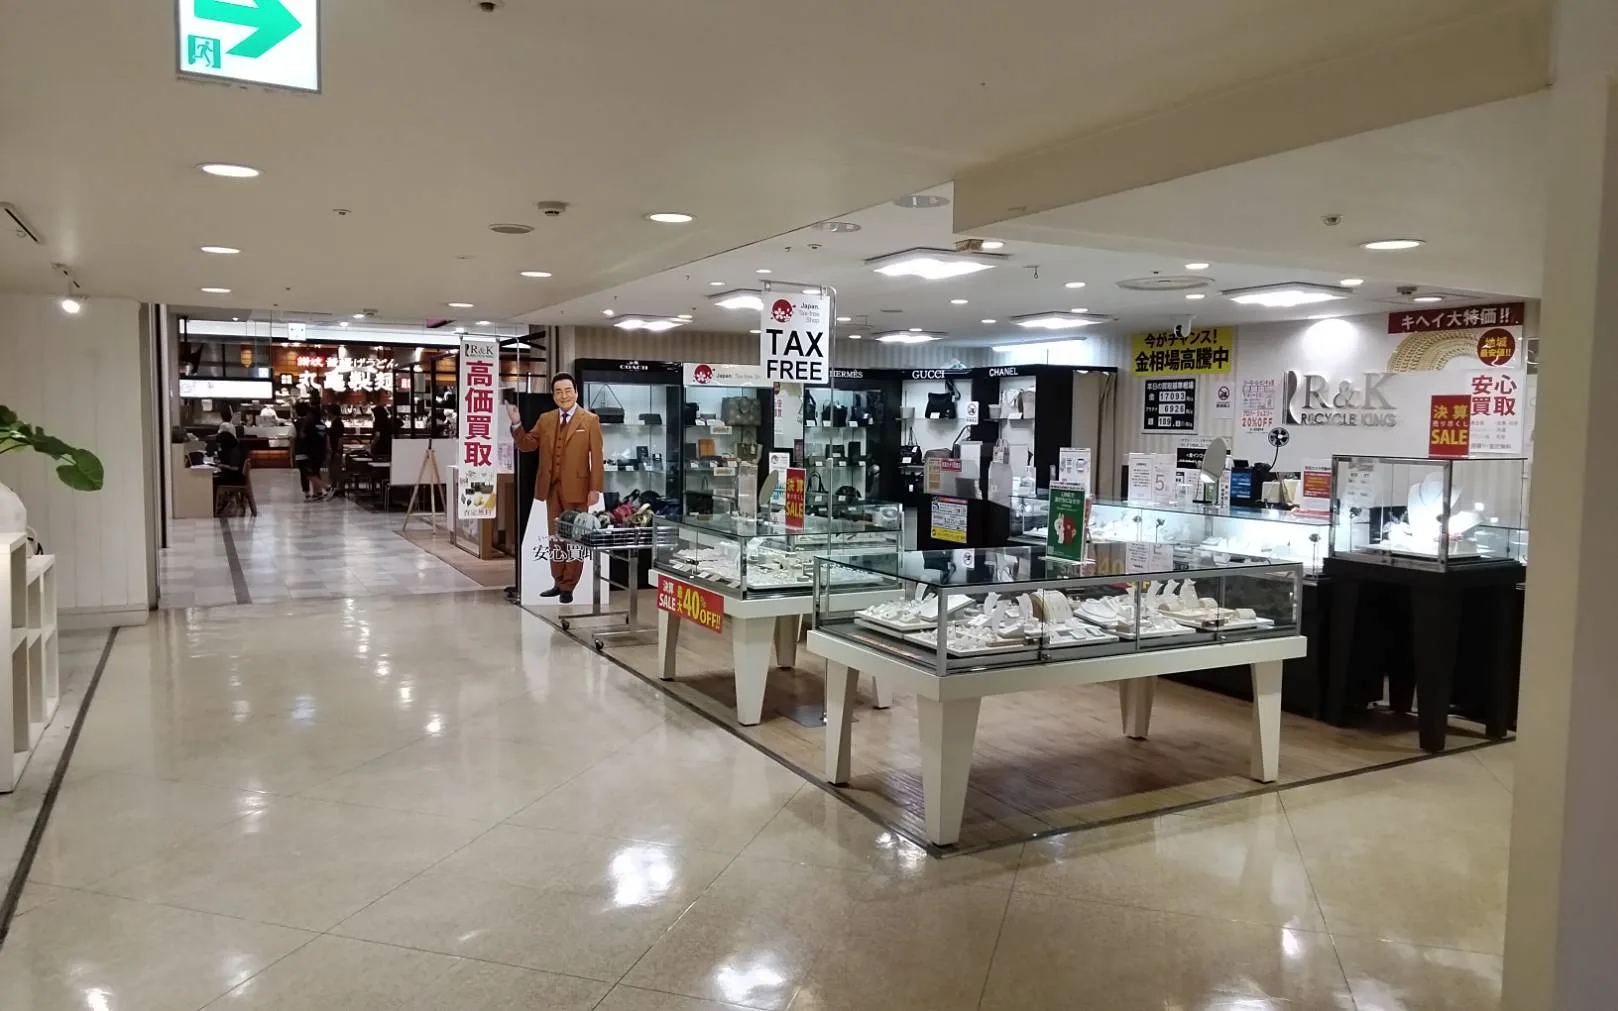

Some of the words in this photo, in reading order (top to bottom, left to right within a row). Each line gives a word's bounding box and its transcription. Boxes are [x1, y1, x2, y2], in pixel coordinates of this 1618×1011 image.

[766, 329, 823, 357] TAX
[1135, 346, 1229, 372] 金相場高騰中
[767, 360, 822, 380] FREE
[911, 370, 945, 379] GUCCI
[989, 367, 1018, 377] CHANEL
[1301, 372, 1398, 410] R&K
[1471, 374, 1517, 395] 安心
[464, 360, 494, 467] 高価買取
[1471, 396, 1516, 416] 買取
[1301, 413, 1357, 426] RECYCLE
[1361, 413, 1397, 428] KING
[1431, 429, 1467, 445] SALE
[786, 501, 803, 517] SALE
[659, 593, 676, 611] SALE
